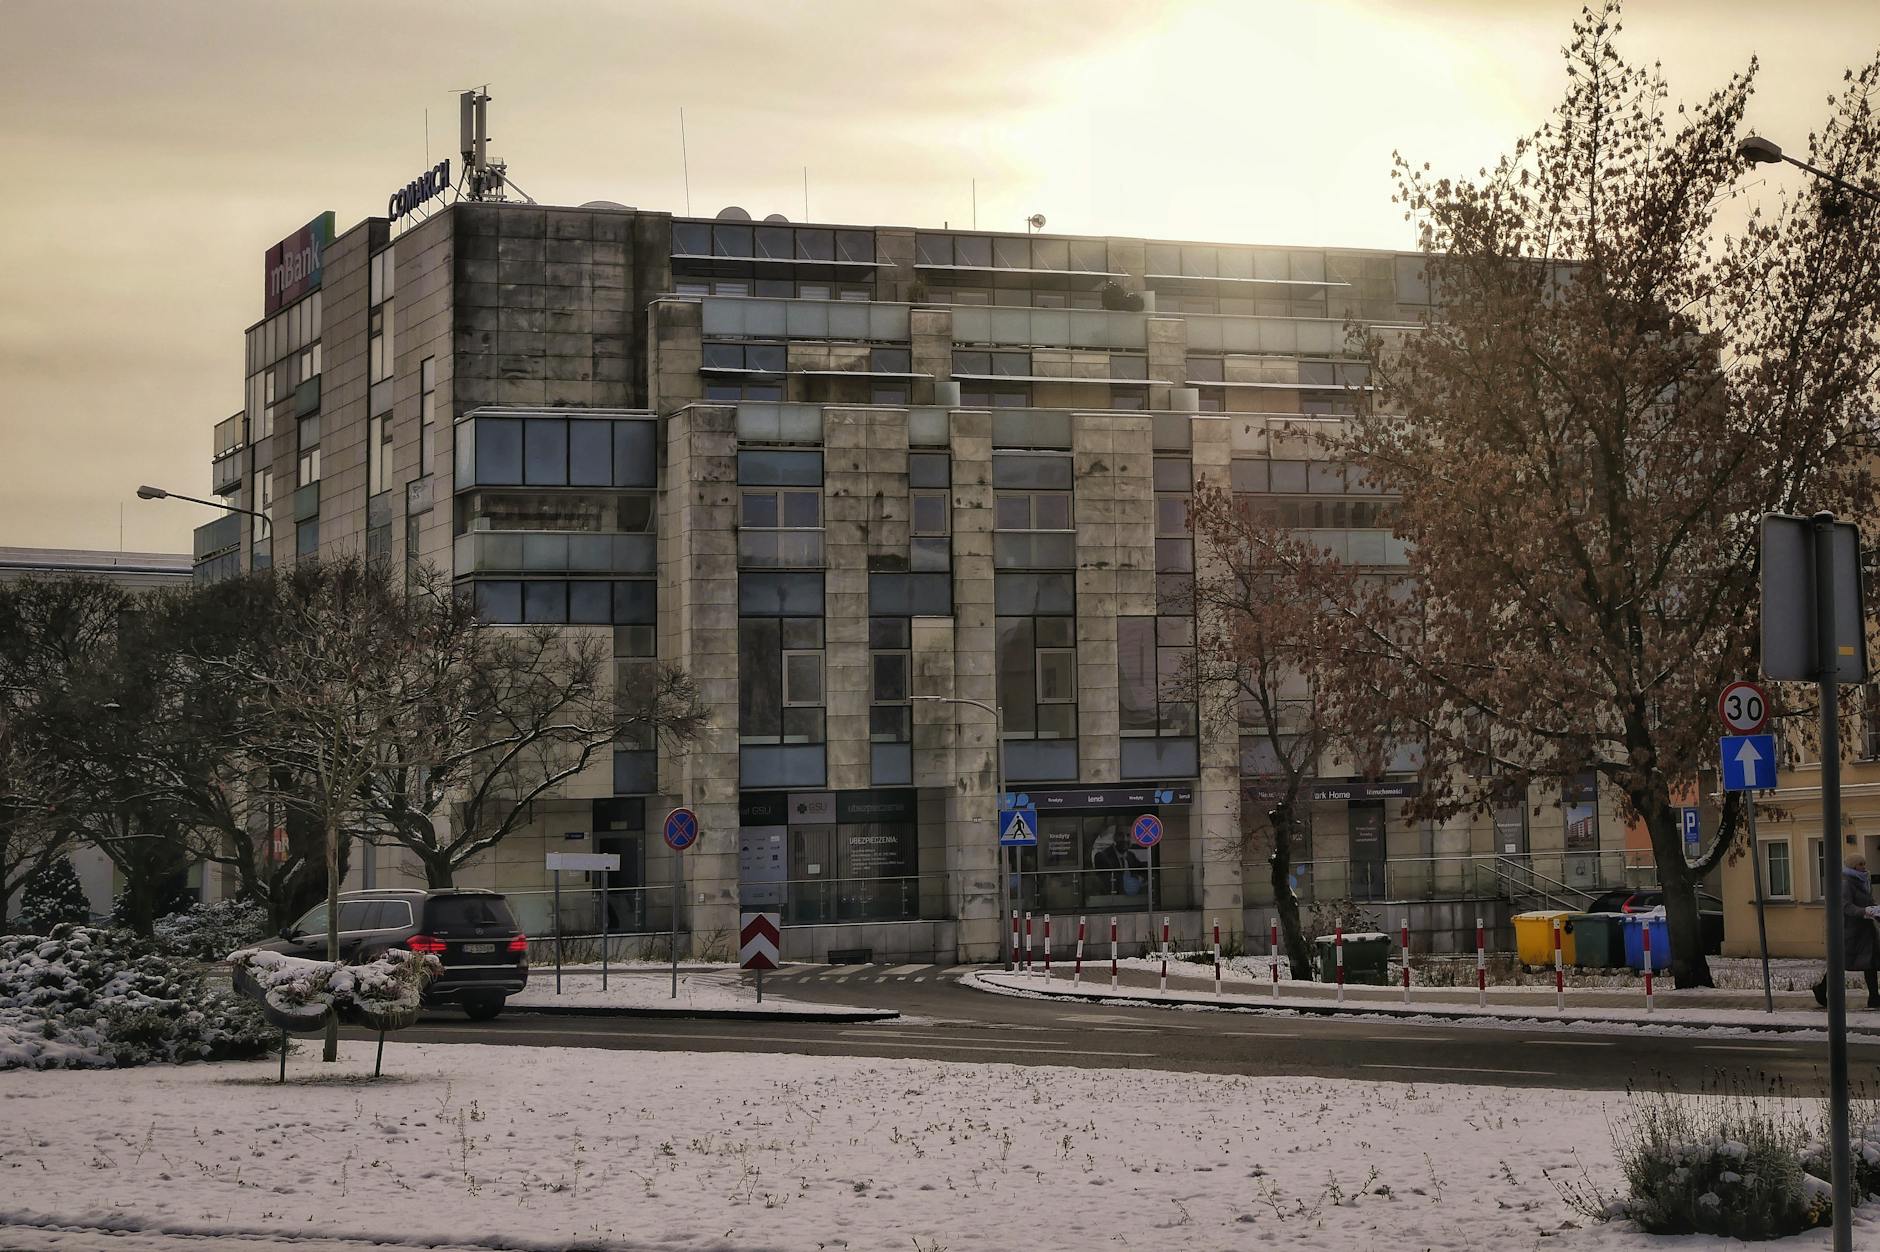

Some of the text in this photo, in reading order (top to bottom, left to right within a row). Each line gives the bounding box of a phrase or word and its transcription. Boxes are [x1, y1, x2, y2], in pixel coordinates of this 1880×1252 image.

[388, 158, 450, 222] COMARCH
[271, 232, 321, 297] mBank
[1726, 695, 1763, 722] 30
[1328, 790, 1351, 799] Home
[1686, 812, 1696, 833] P
